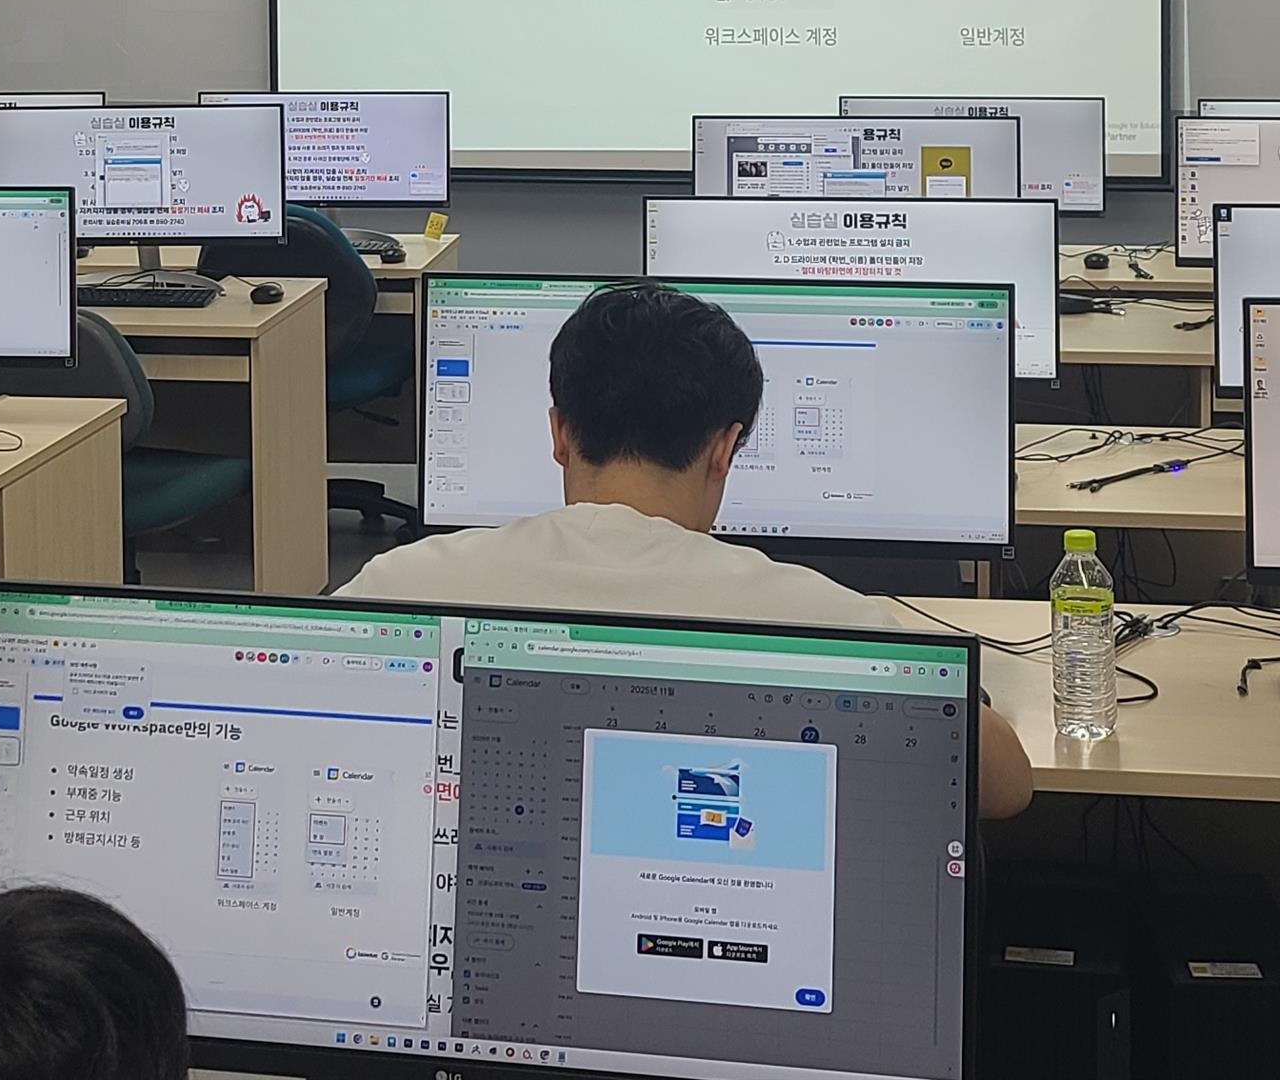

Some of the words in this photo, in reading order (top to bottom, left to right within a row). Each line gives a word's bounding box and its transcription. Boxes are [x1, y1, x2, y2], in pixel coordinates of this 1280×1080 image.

[704, 27, 800, 46] 워크스페이스
[806, 27, 838, 46] 계정
[960, 28, 1025, 46] 일반계정
[128, 116, 175, 129] 이용규칙
[790, 212, 838, 229] 실습실
[843, 213, 907, 229] 이용규칙
[506, 677, 541, 688] Calendar
[630, 685, 657, 696] 2025년
[660, 687, 675, 697] 11월
[215, 723, 242, 741] 기능
[655, 721, 666, 730] 24
[705, 724, 717, 734] 25
[754, 727, 766, 738] 26
[804, 730, 816, 741] 27
[854, 734, 866, 744] 28
[905, 737, 917, 748] 29
[67, 764, 109, 779] 약속일정
[112, 766, 134, 781] 생성
[342, 771, 374, 781] Calendar
[66, 786, 98, 801] 부재중
[101, 787, 122, 802] 기능
[65, 809, 86, 822] 근무
[88, 810, 111, 824] 위치
[64, 831, 127, 848] 방해금지시간
[130, 835, 141, 849] 등
[658, 874, 680, 883] Google
